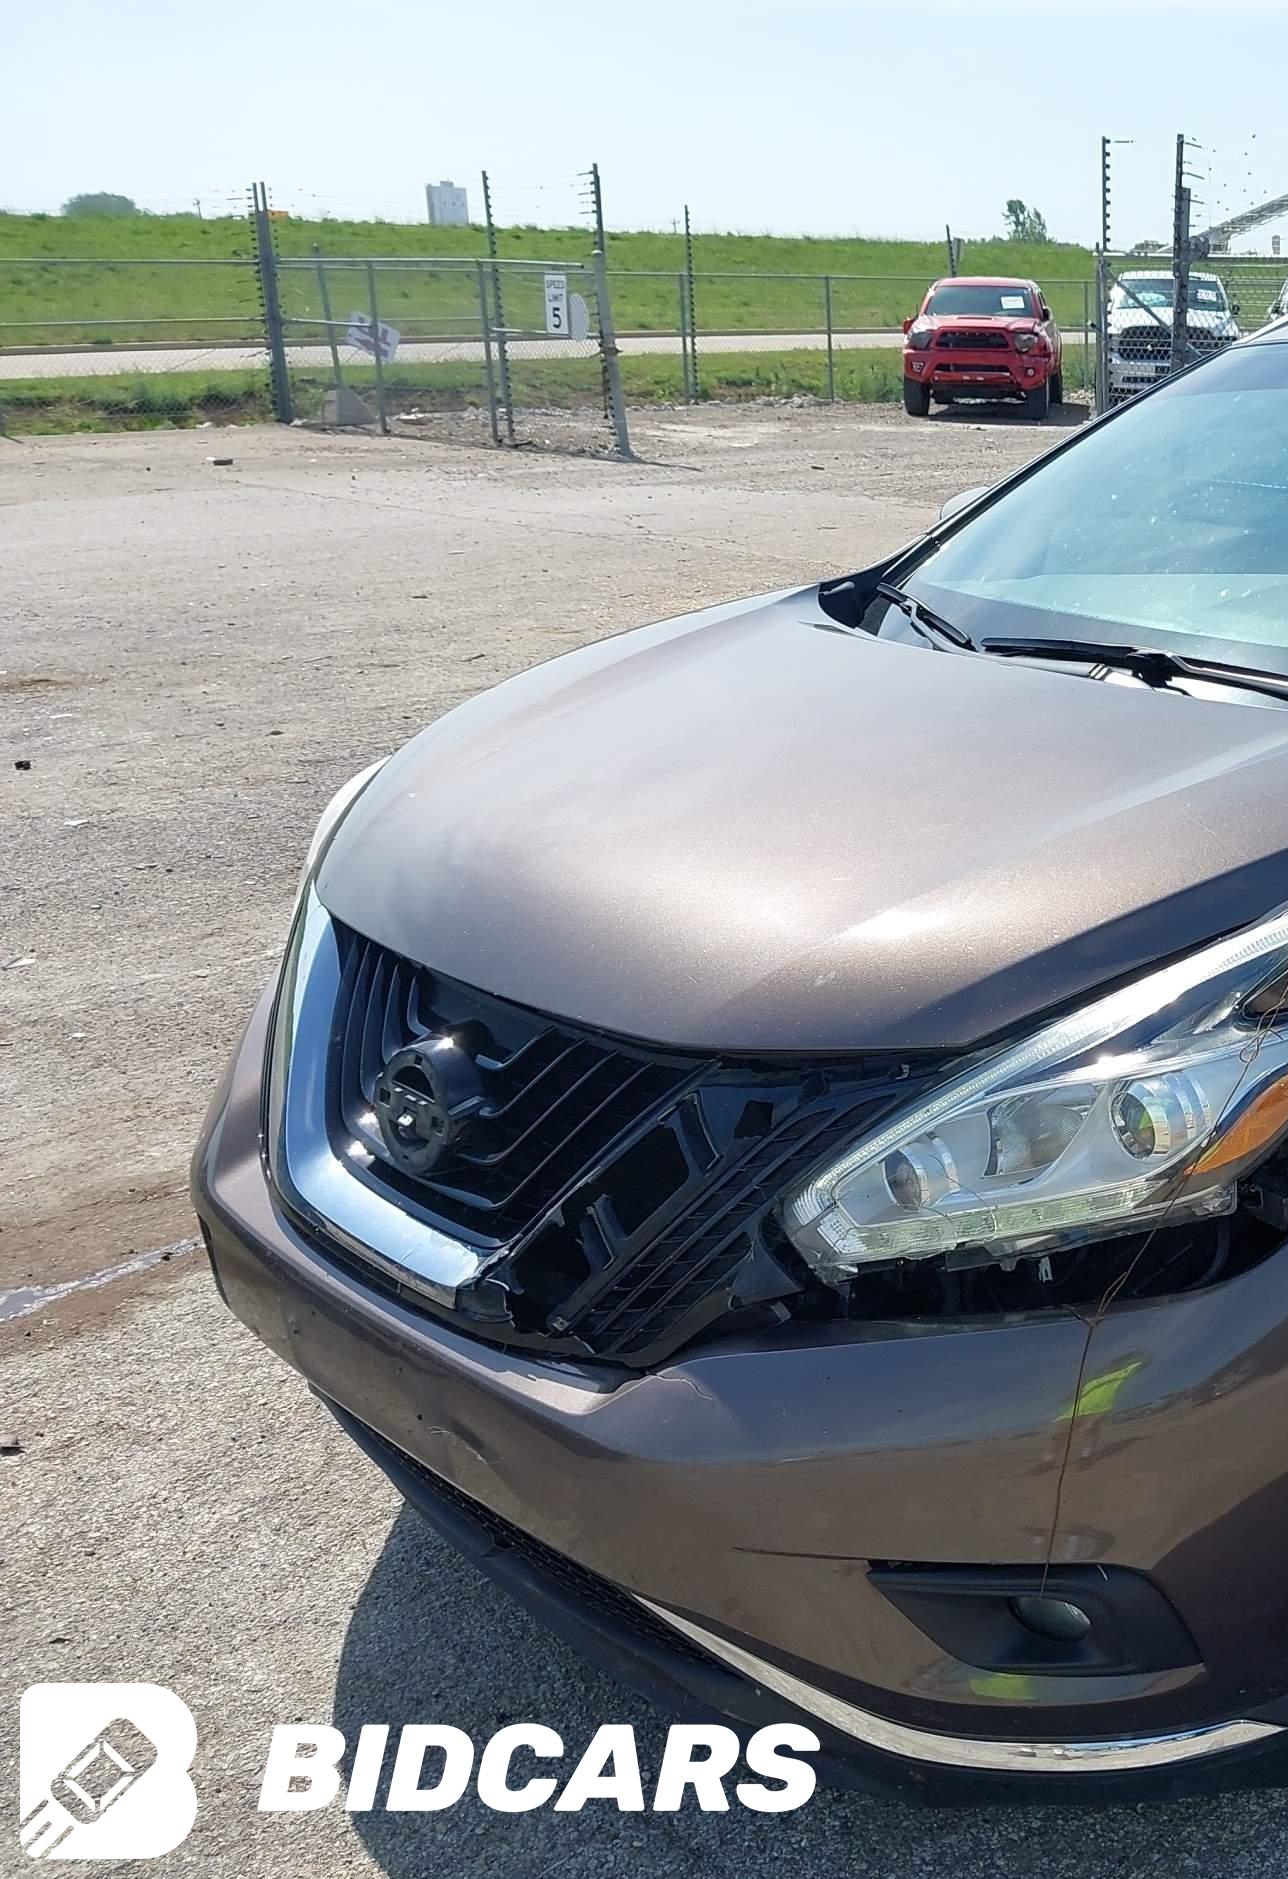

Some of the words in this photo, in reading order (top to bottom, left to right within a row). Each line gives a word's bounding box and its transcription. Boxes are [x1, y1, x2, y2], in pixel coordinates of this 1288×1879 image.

[546, 279, 565, 289] SPEED
[547, 292, 563, 302] LIMIT
[552, 306, 562, 329] 5
